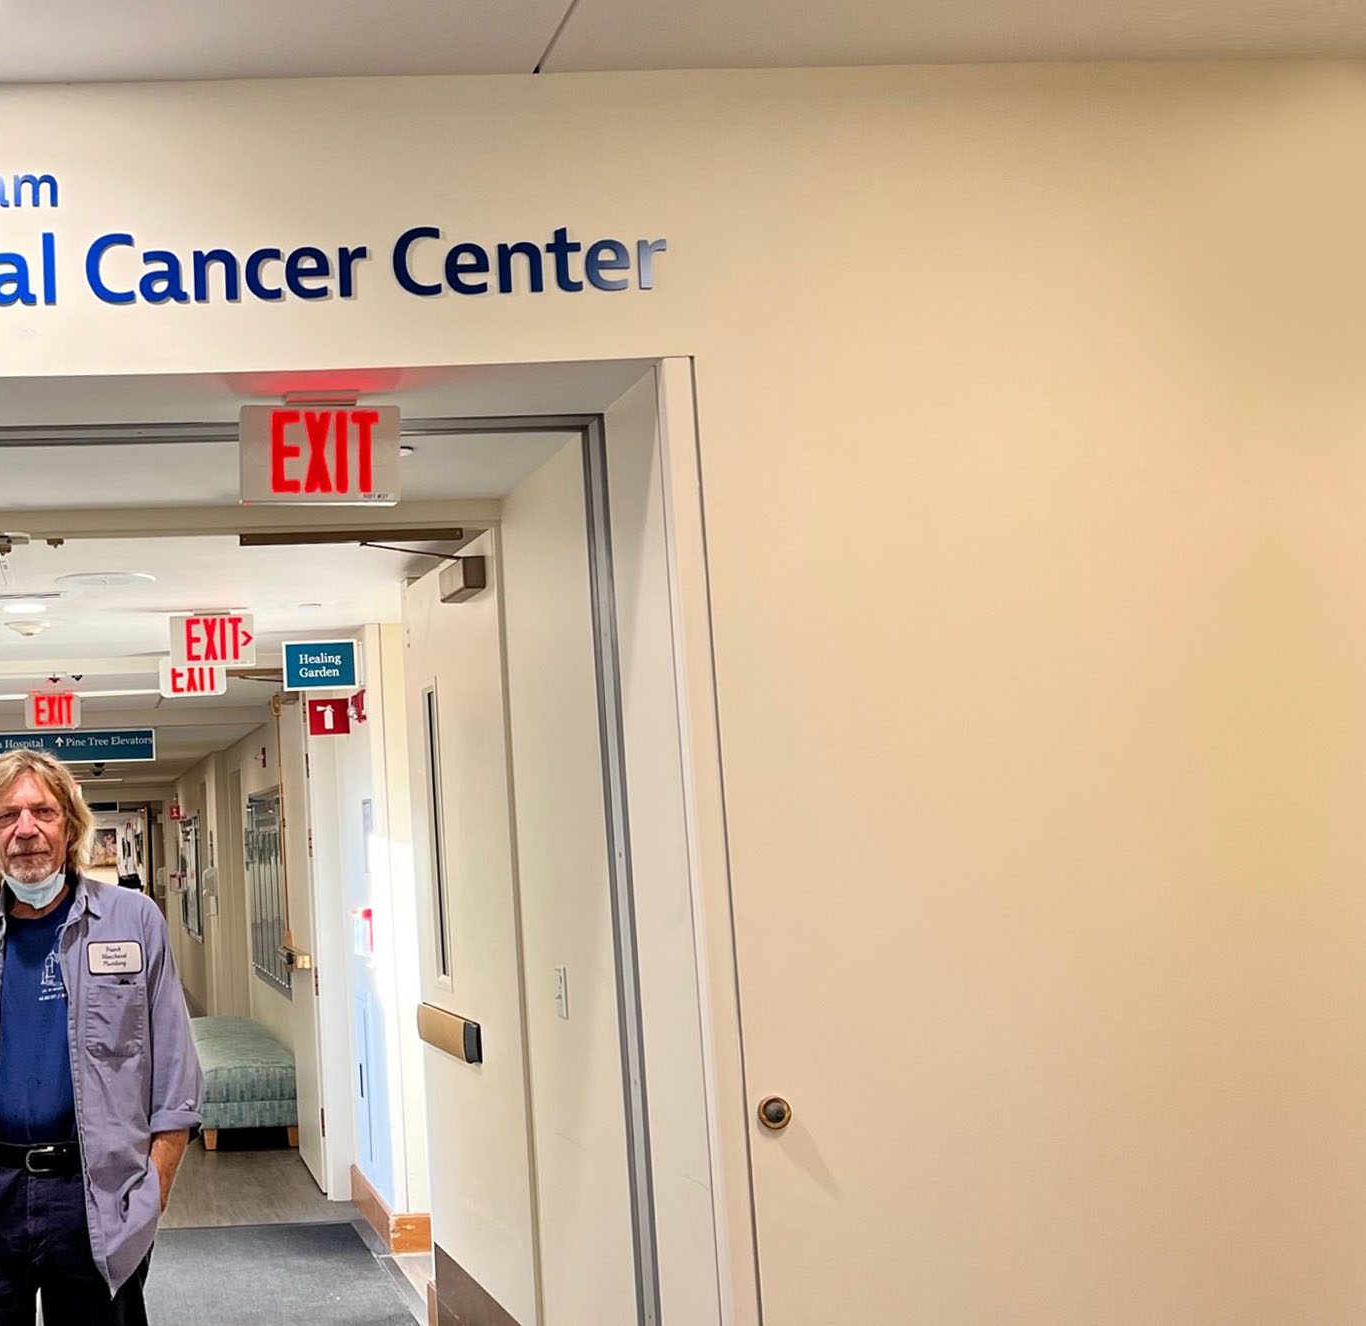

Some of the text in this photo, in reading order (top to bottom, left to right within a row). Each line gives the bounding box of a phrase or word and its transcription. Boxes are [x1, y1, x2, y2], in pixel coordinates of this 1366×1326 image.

[85, 232, 367, 305] Cancer
[392, 227, 666, 297] Center
[270, 409, 380, 494] EXIT
[185, 616, 242, 662] EXIT
[298, 652, 342, 665] Healing
[299, 667, 340, 678] Garden
[34, 694, 73, 727] EXIT
[4, 738, 44, 750] Hospital
[65, 735, 153, 748] Pine Tree Elevators
